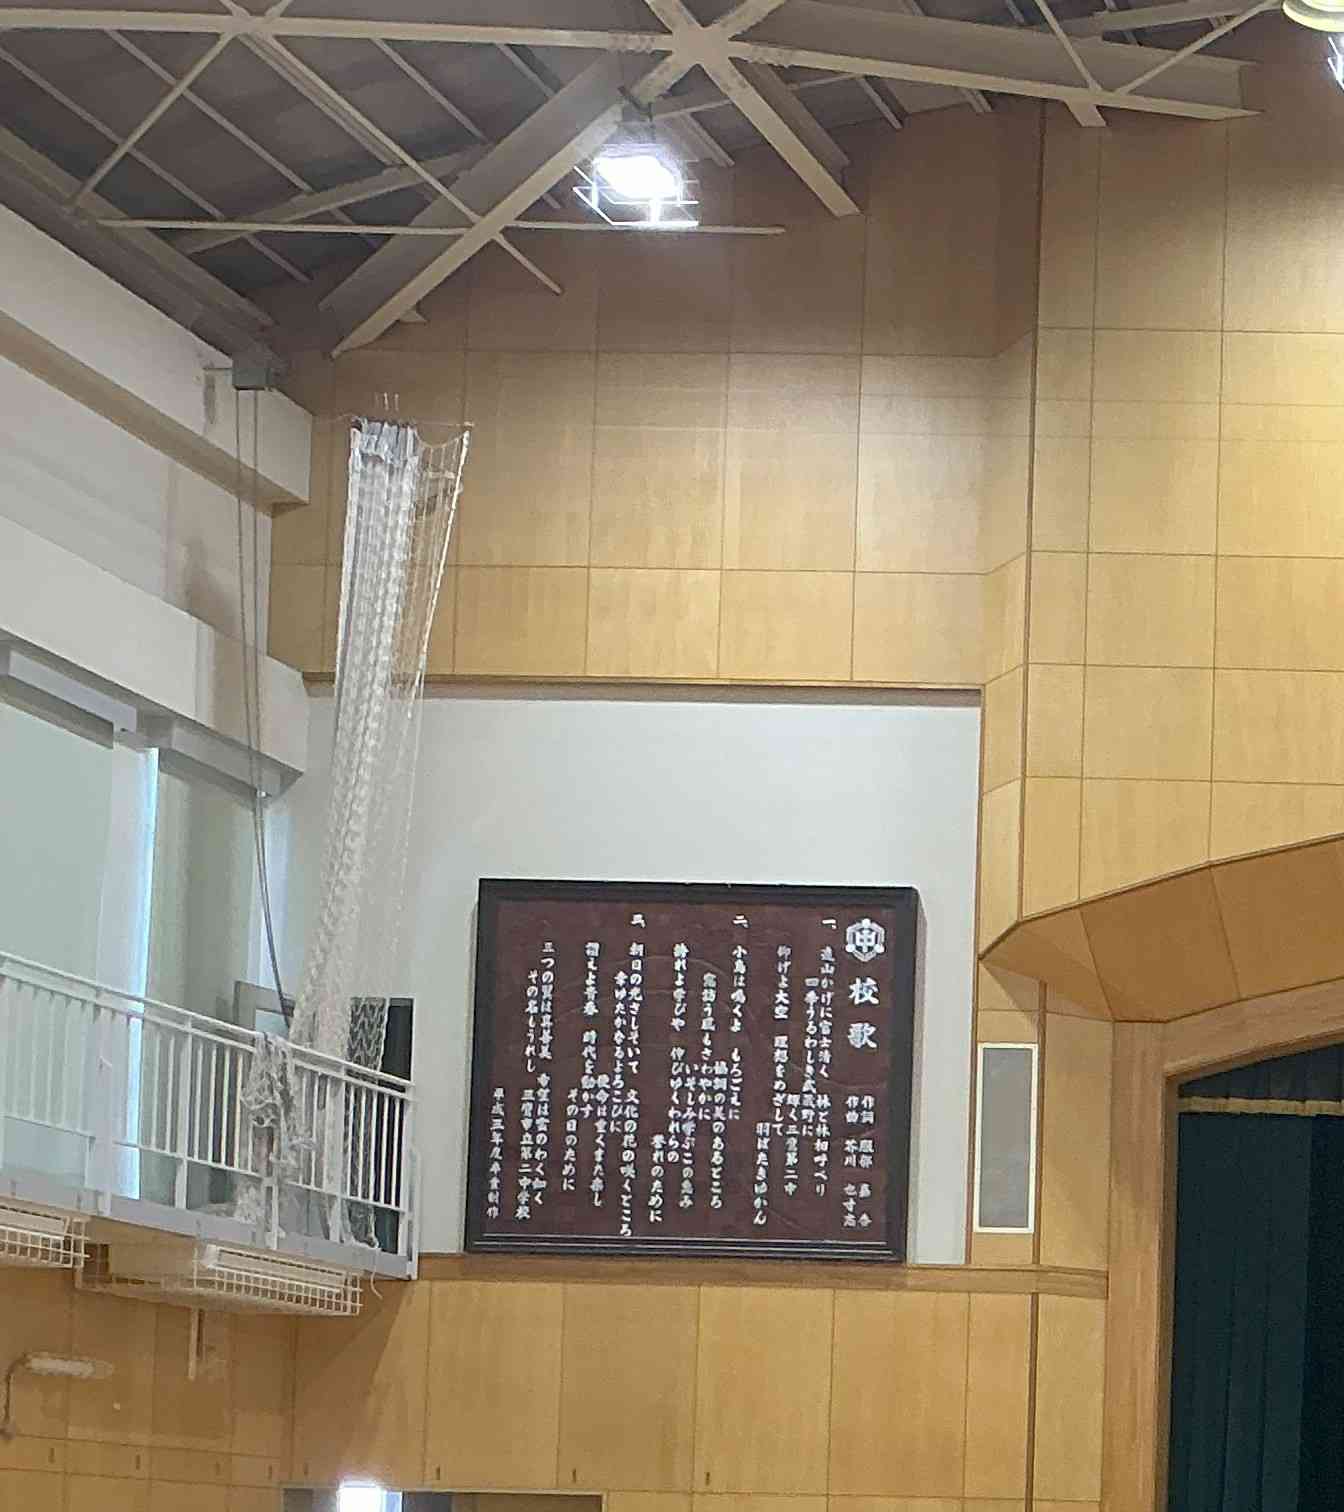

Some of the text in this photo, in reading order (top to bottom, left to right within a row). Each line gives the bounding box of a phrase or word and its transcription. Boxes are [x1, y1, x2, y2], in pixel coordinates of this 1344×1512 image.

[848, 976, 880, 1049] 校歌
[561, 1088, 580, 1192] その日のために
